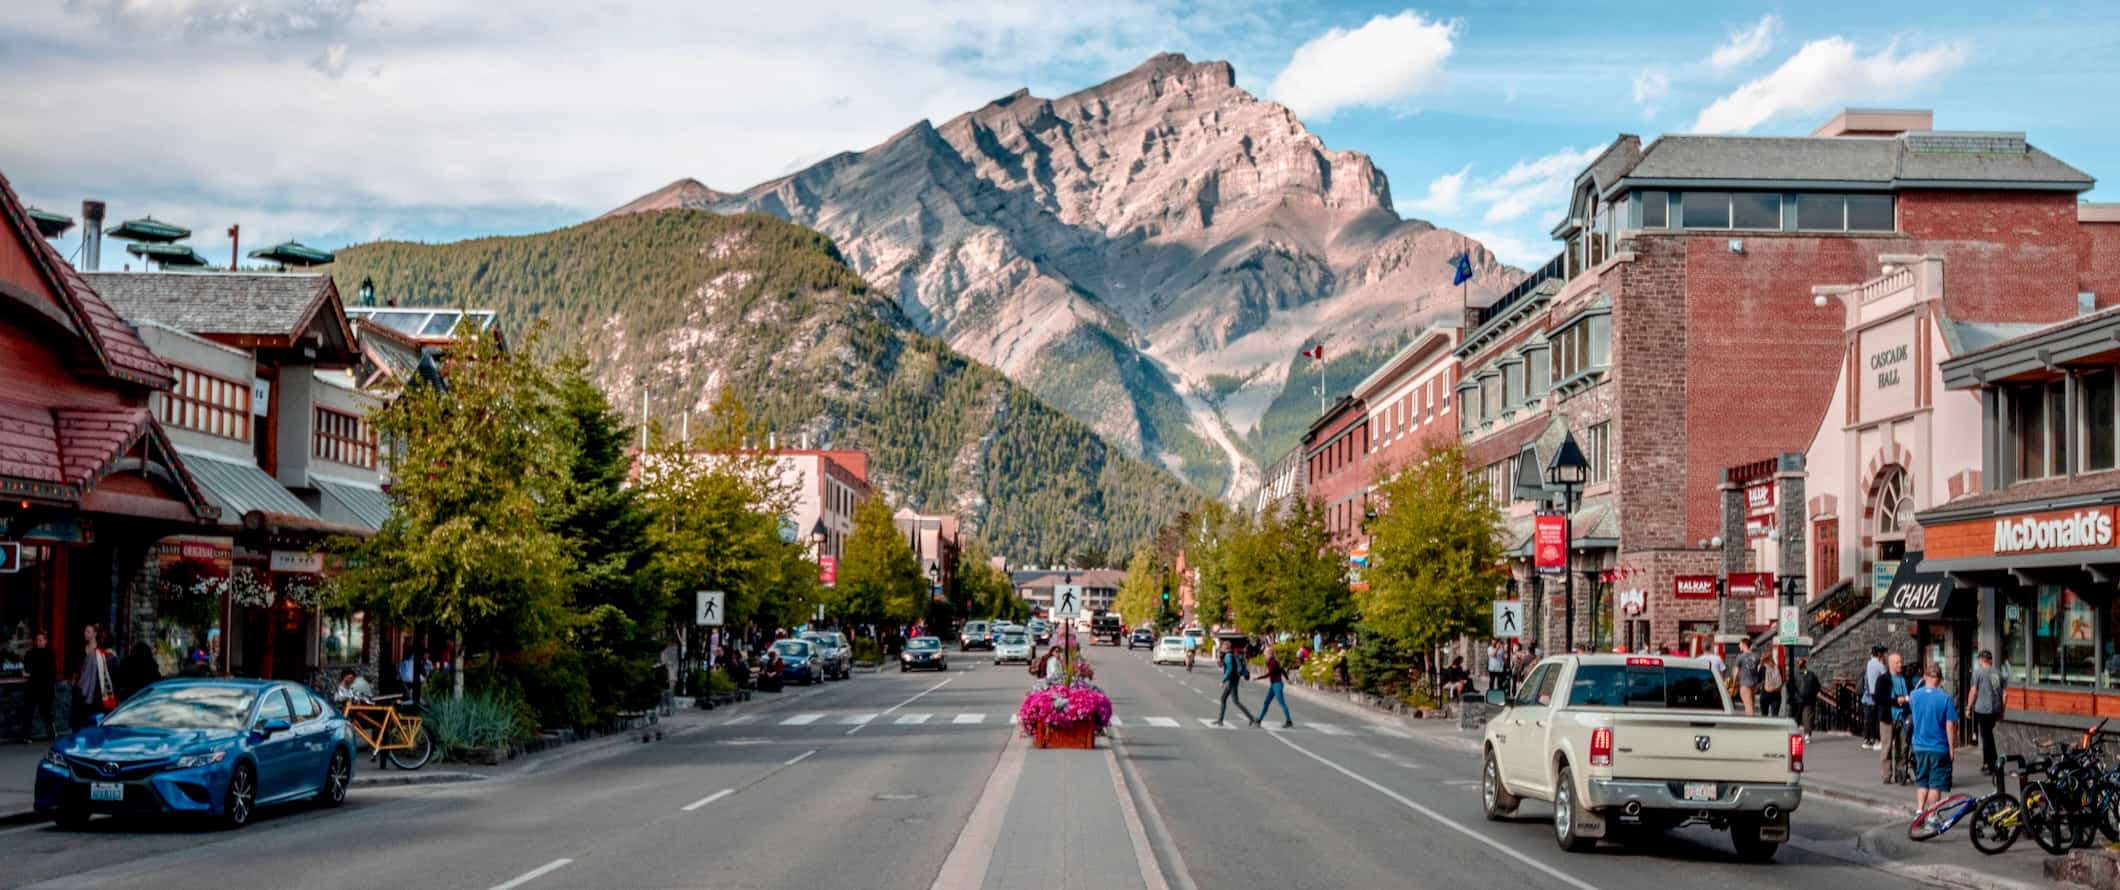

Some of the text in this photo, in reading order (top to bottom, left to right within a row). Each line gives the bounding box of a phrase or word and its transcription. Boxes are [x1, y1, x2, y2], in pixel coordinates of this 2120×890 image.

[1870, 344, 1908, 370] CASCADE
[1878, 368, 1900, 389] HALL
[1994, 511, 2112, 552] McDonald's
[1893, 583, 1941, 608] CHAYA
